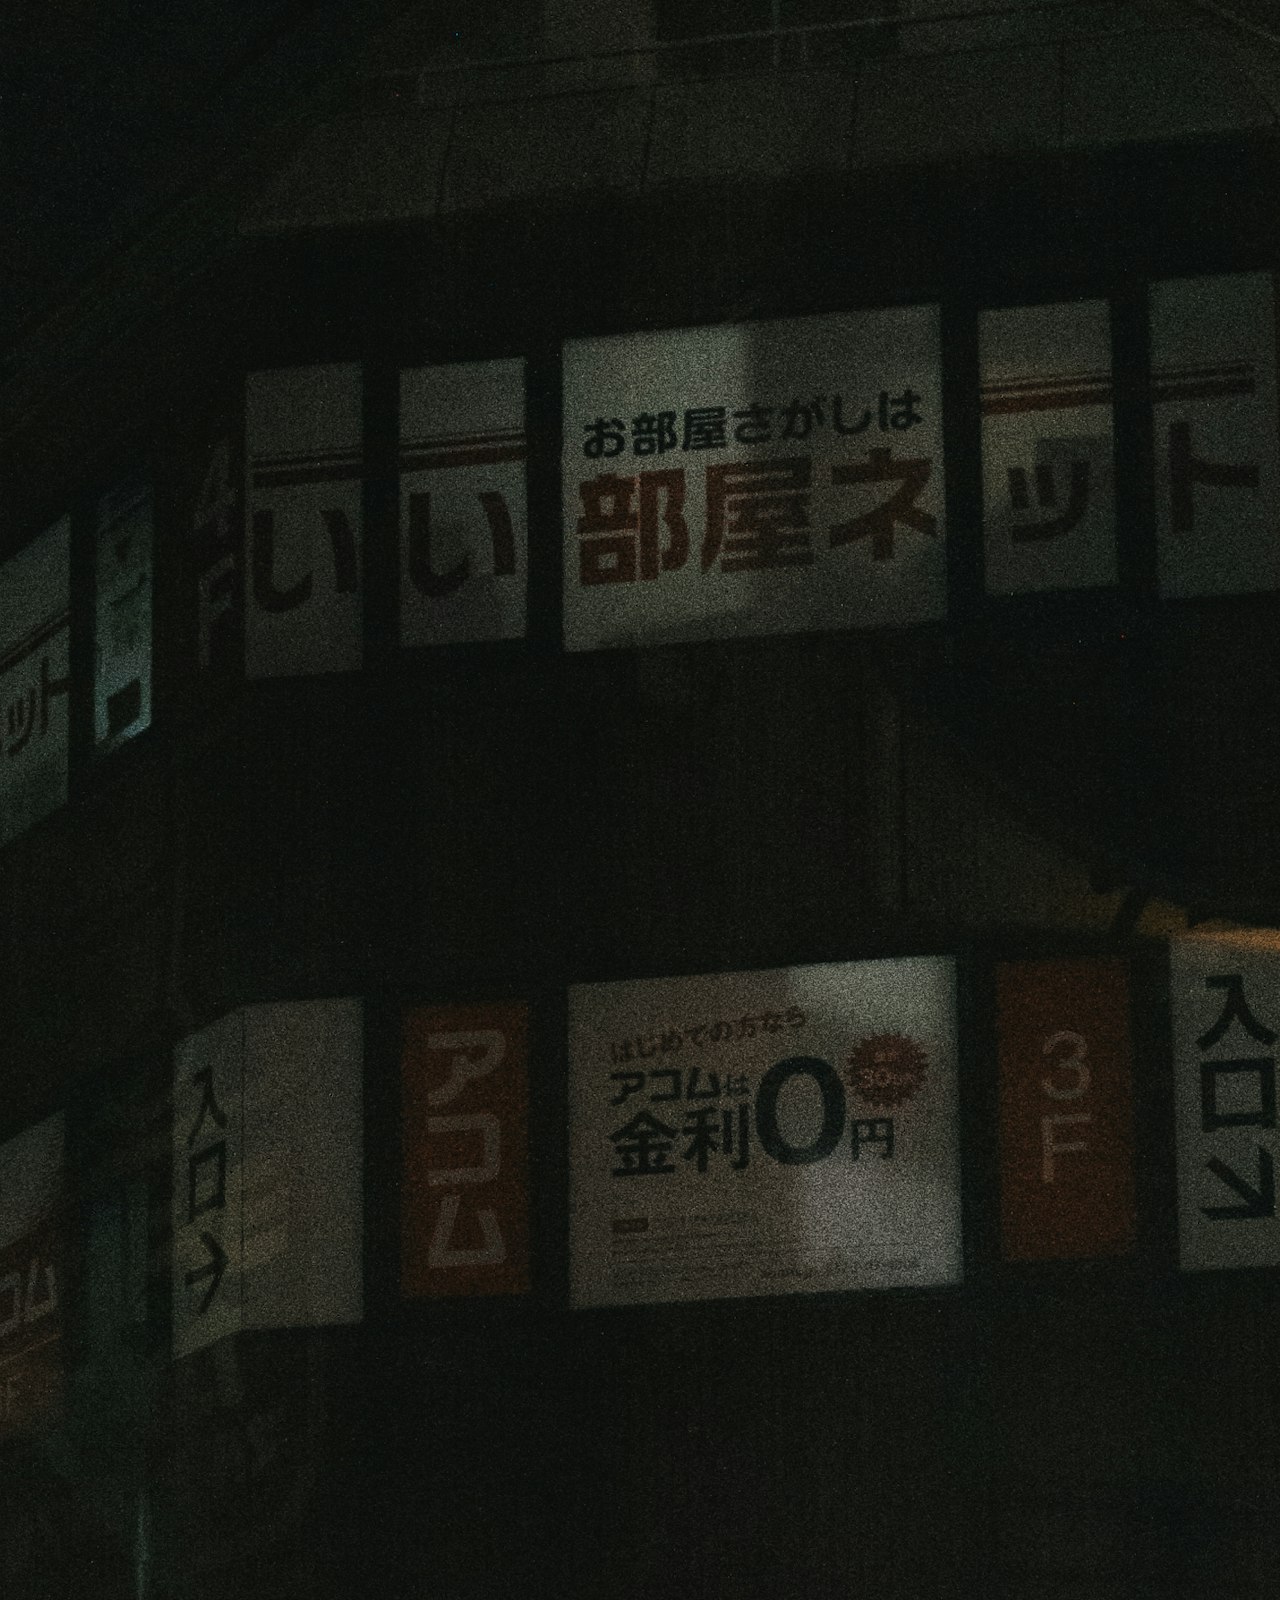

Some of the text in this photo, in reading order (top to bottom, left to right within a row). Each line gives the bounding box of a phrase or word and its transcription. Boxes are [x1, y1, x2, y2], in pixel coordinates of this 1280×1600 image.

[582, 388, 923, 460] お部屋さがしは
[608, 1055, 898, 1178] 金利0円
[1042, 1029, 1092, 1184] 3F
[1197, 972, 1277, 1133] 入口
[427, 1029, 507, 1270] アコム
